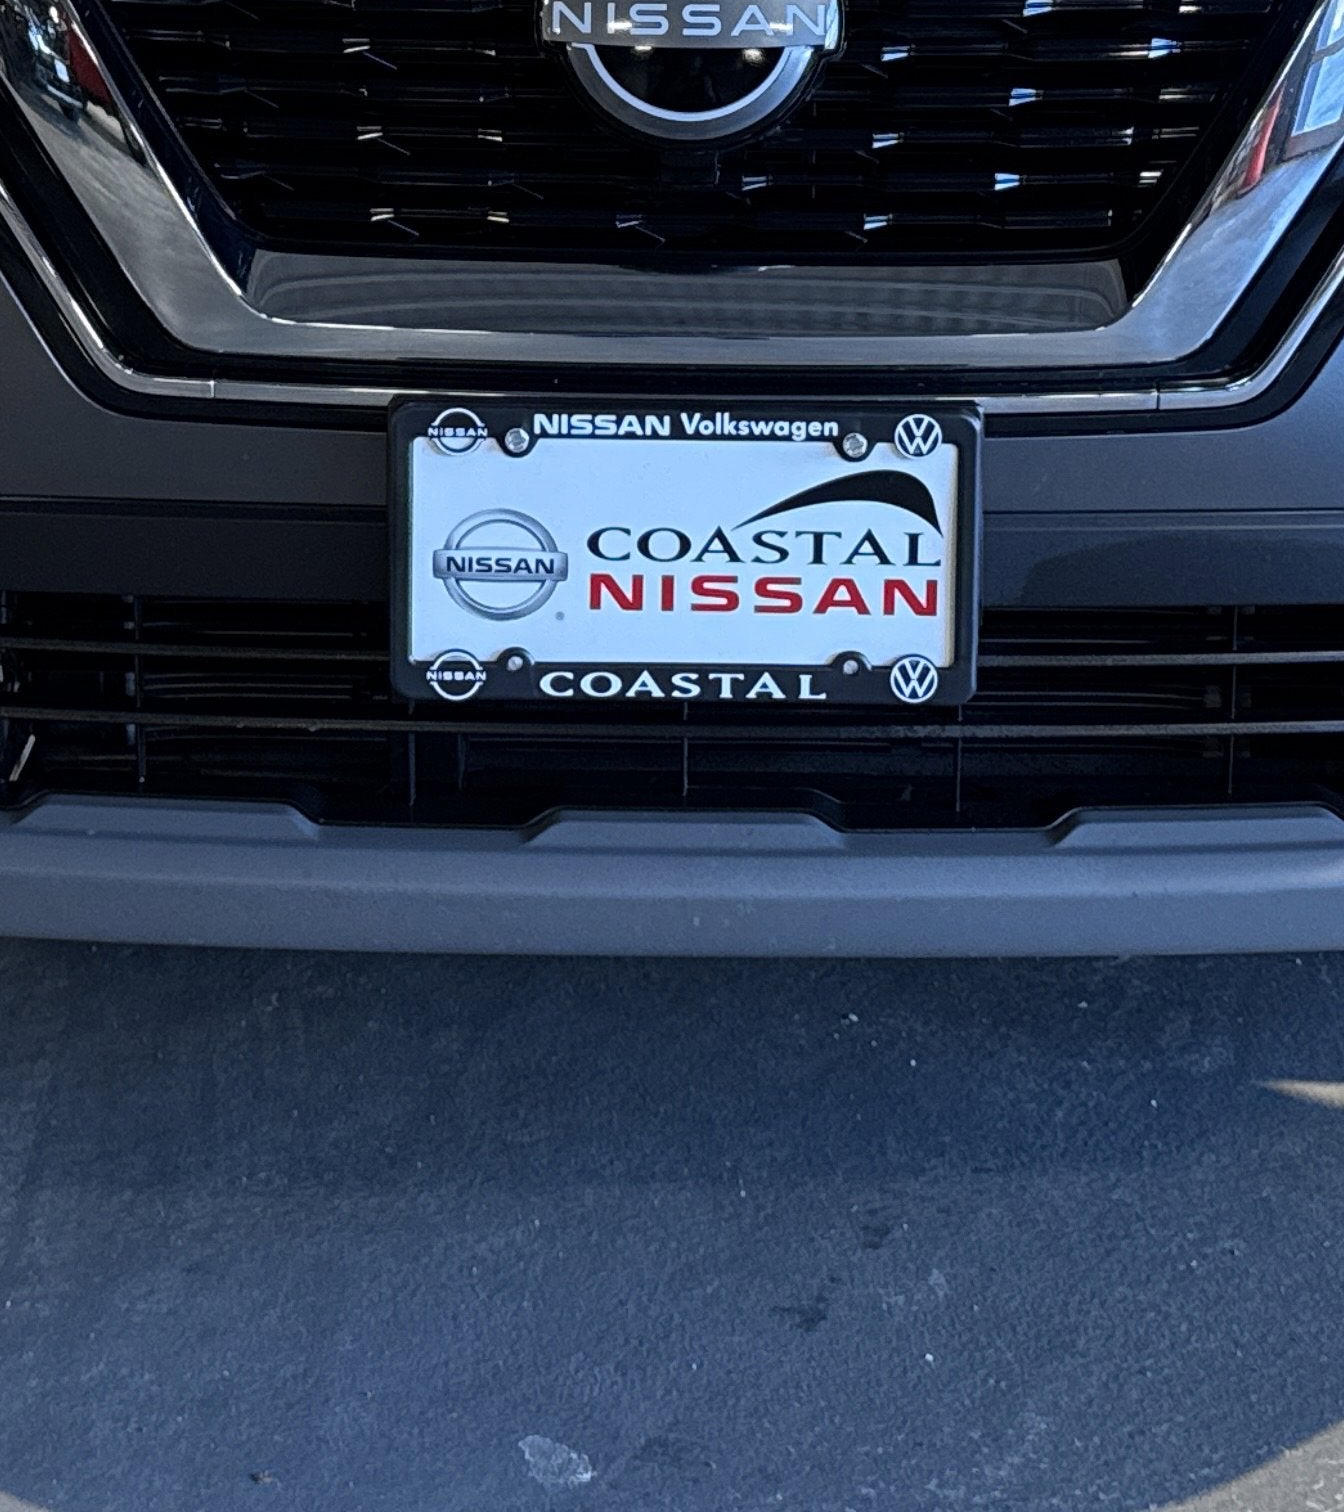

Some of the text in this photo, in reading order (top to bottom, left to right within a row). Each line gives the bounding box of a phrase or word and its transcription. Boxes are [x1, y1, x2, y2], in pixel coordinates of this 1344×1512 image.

[551, 0, 827, 37] NISSAN
[427, 427, 488, 438] NISSAN
[533, 411, 839, 442] NISSAN Volkswagen
[894, 414, 943, 460] VW
[586, 525, 942, 567] COASTAL
[446, 556, 555, 574] NISSAN
[589, 573, 938, 617] NISSAN
[425, 671, 486, 682] NISSAN
[539, 669, 827, 700] COASTAL
[890, 656, 938, 704] VW
